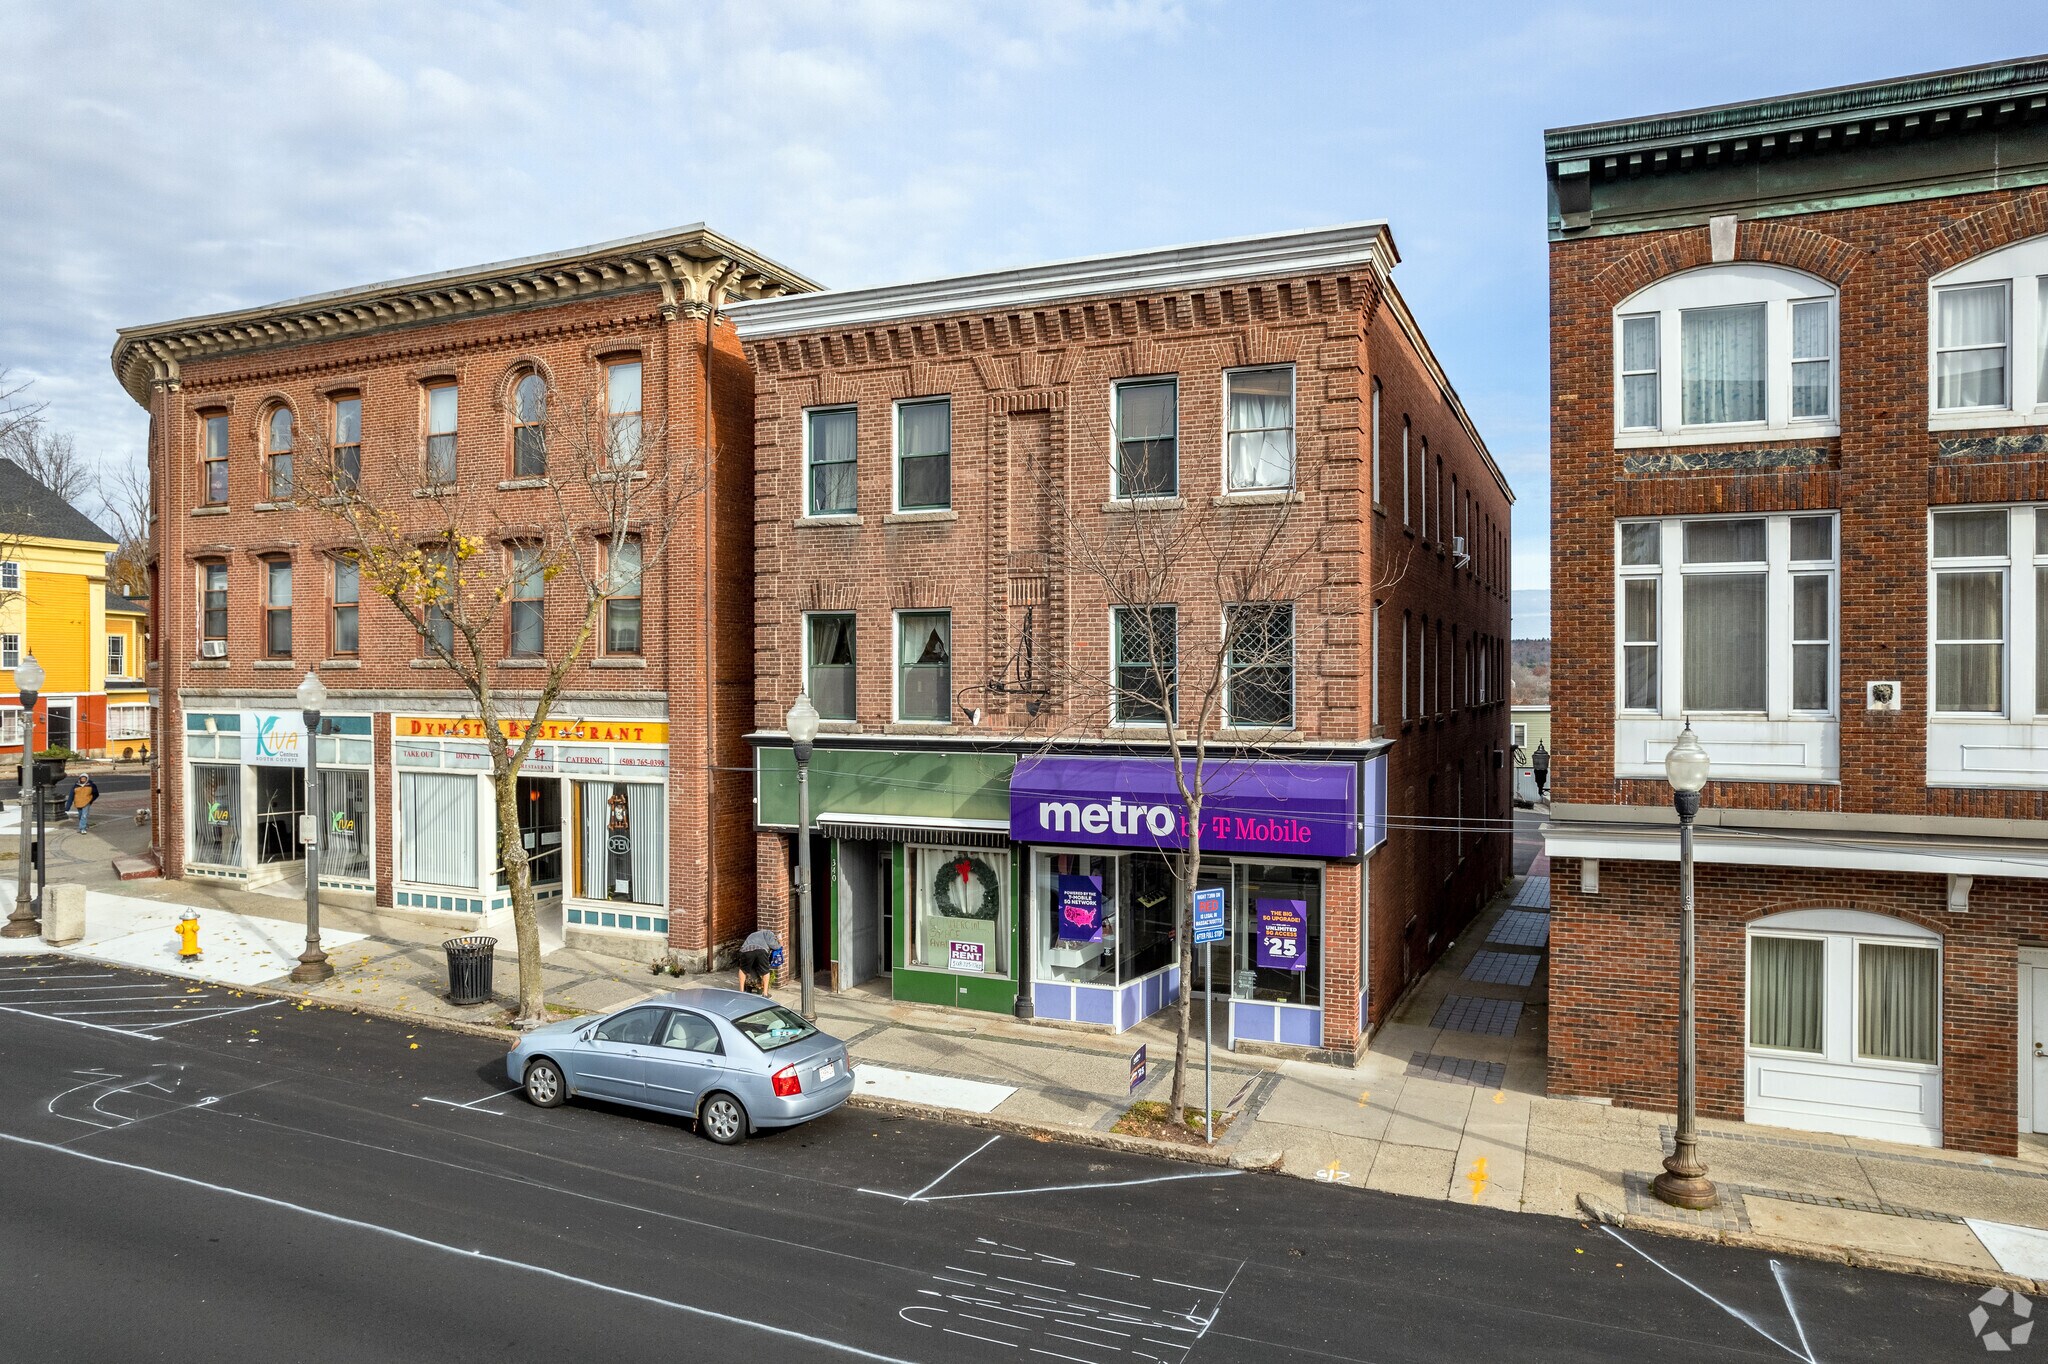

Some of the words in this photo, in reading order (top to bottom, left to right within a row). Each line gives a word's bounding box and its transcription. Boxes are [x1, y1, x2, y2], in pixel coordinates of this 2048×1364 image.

[411, 720, 492, 737] DYNAST
[254, 713, 298, 756] KIVA
[403, 750, 418, 758] TAKE
[455, 752, 471, 760] DINE
[565, 756, 603, 764] CATERING
[619, 757, 636, 766] (508)
[1039, 796, 1176, 837] metro
[1234, 817, 1312, 843] Mobile
[609, 838, 631, 850] OPEN
[1199, 900, 1218, 912] RED
[955, 943, 978, 953] FOR
[1264, 937, 1296, 956] $25
[952, 950, 982, 961] RENT
